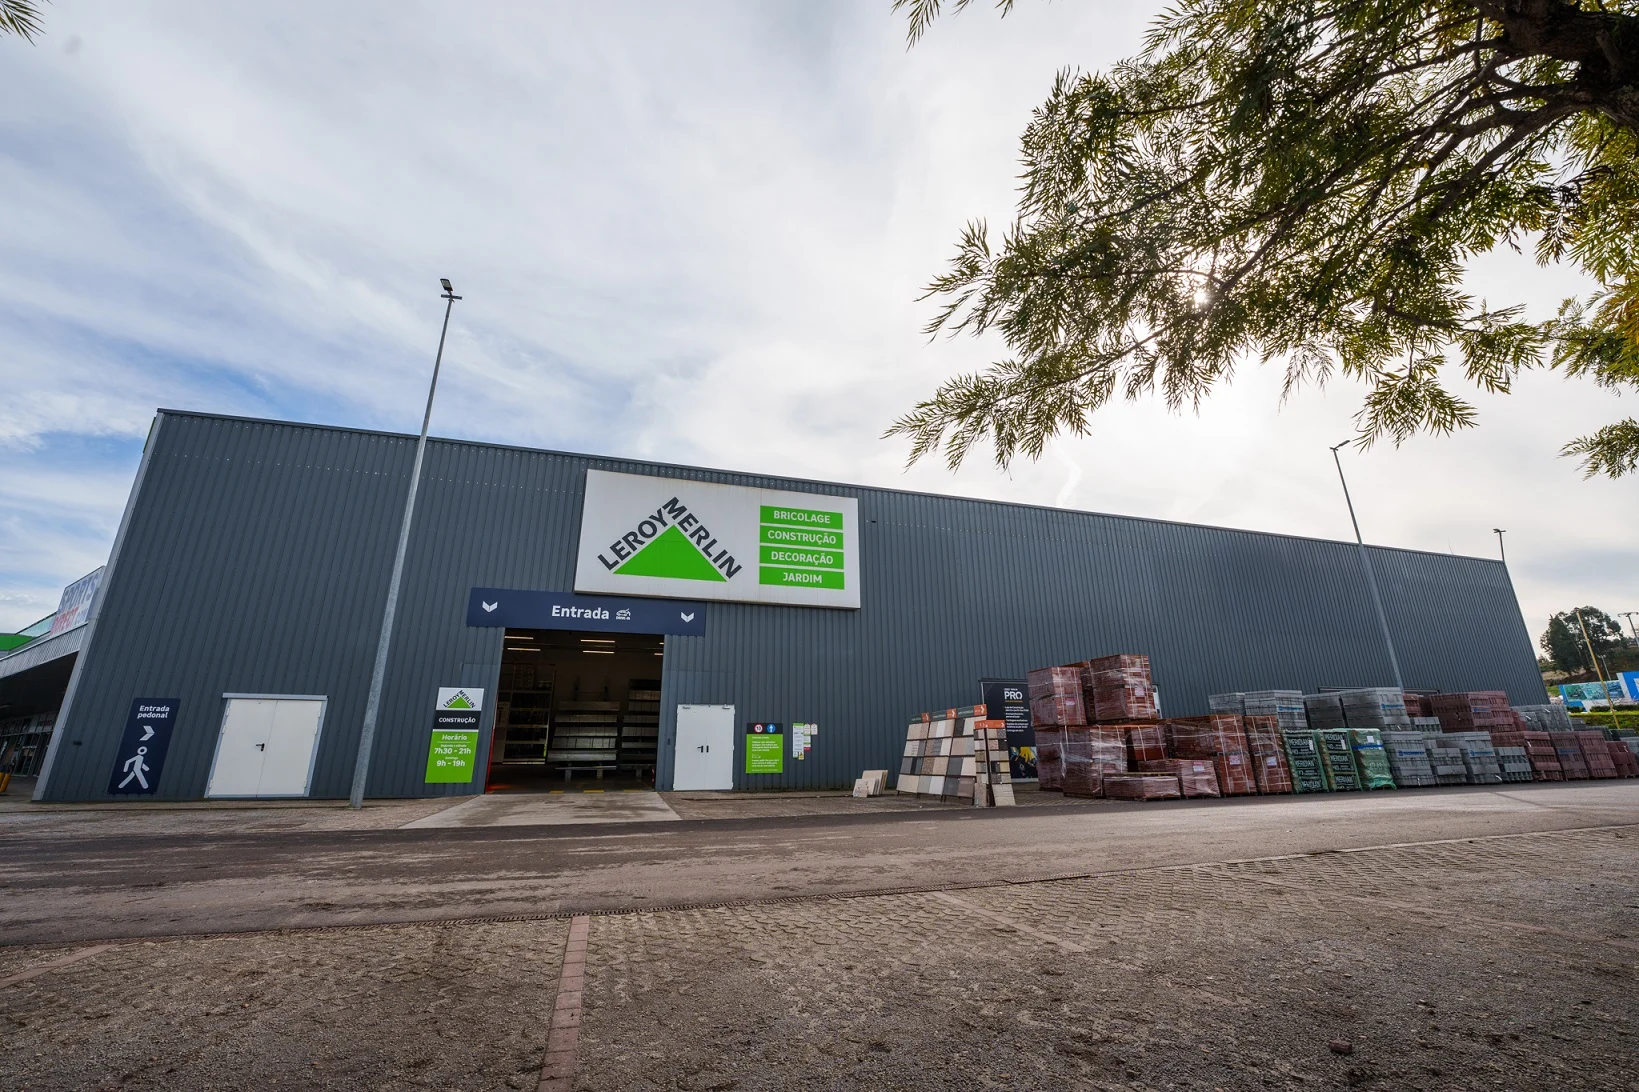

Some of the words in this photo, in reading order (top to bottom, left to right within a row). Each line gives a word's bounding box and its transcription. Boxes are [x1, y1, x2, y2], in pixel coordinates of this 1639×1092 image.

[773, 509, 831, 524] BRICOLAGE
[597, 508, 668, 570] LEROY
[661, 496, 743, 579] MERLIN
[767, 529, 837, 545] CONSTRUÇÃO
[770, 550, 834, 565] DECORAÇÃO
[782, 571, 823, 584] JARDIM
[551, 604, 610, 620] Entrada
[443, 693, 460, 708] LEROY
[458, 689, 476, 709] MERLIN
[1003, 691, 1023, 700] PRO
[139, 704, 171, 713] Entrada
[136, 711, 169, 720] pedonal
[438, 716, 476, 724] CONSTRUÇÃO
[441, 733, 468, 741] Horário
[458, 747, 472, 755] 21h
